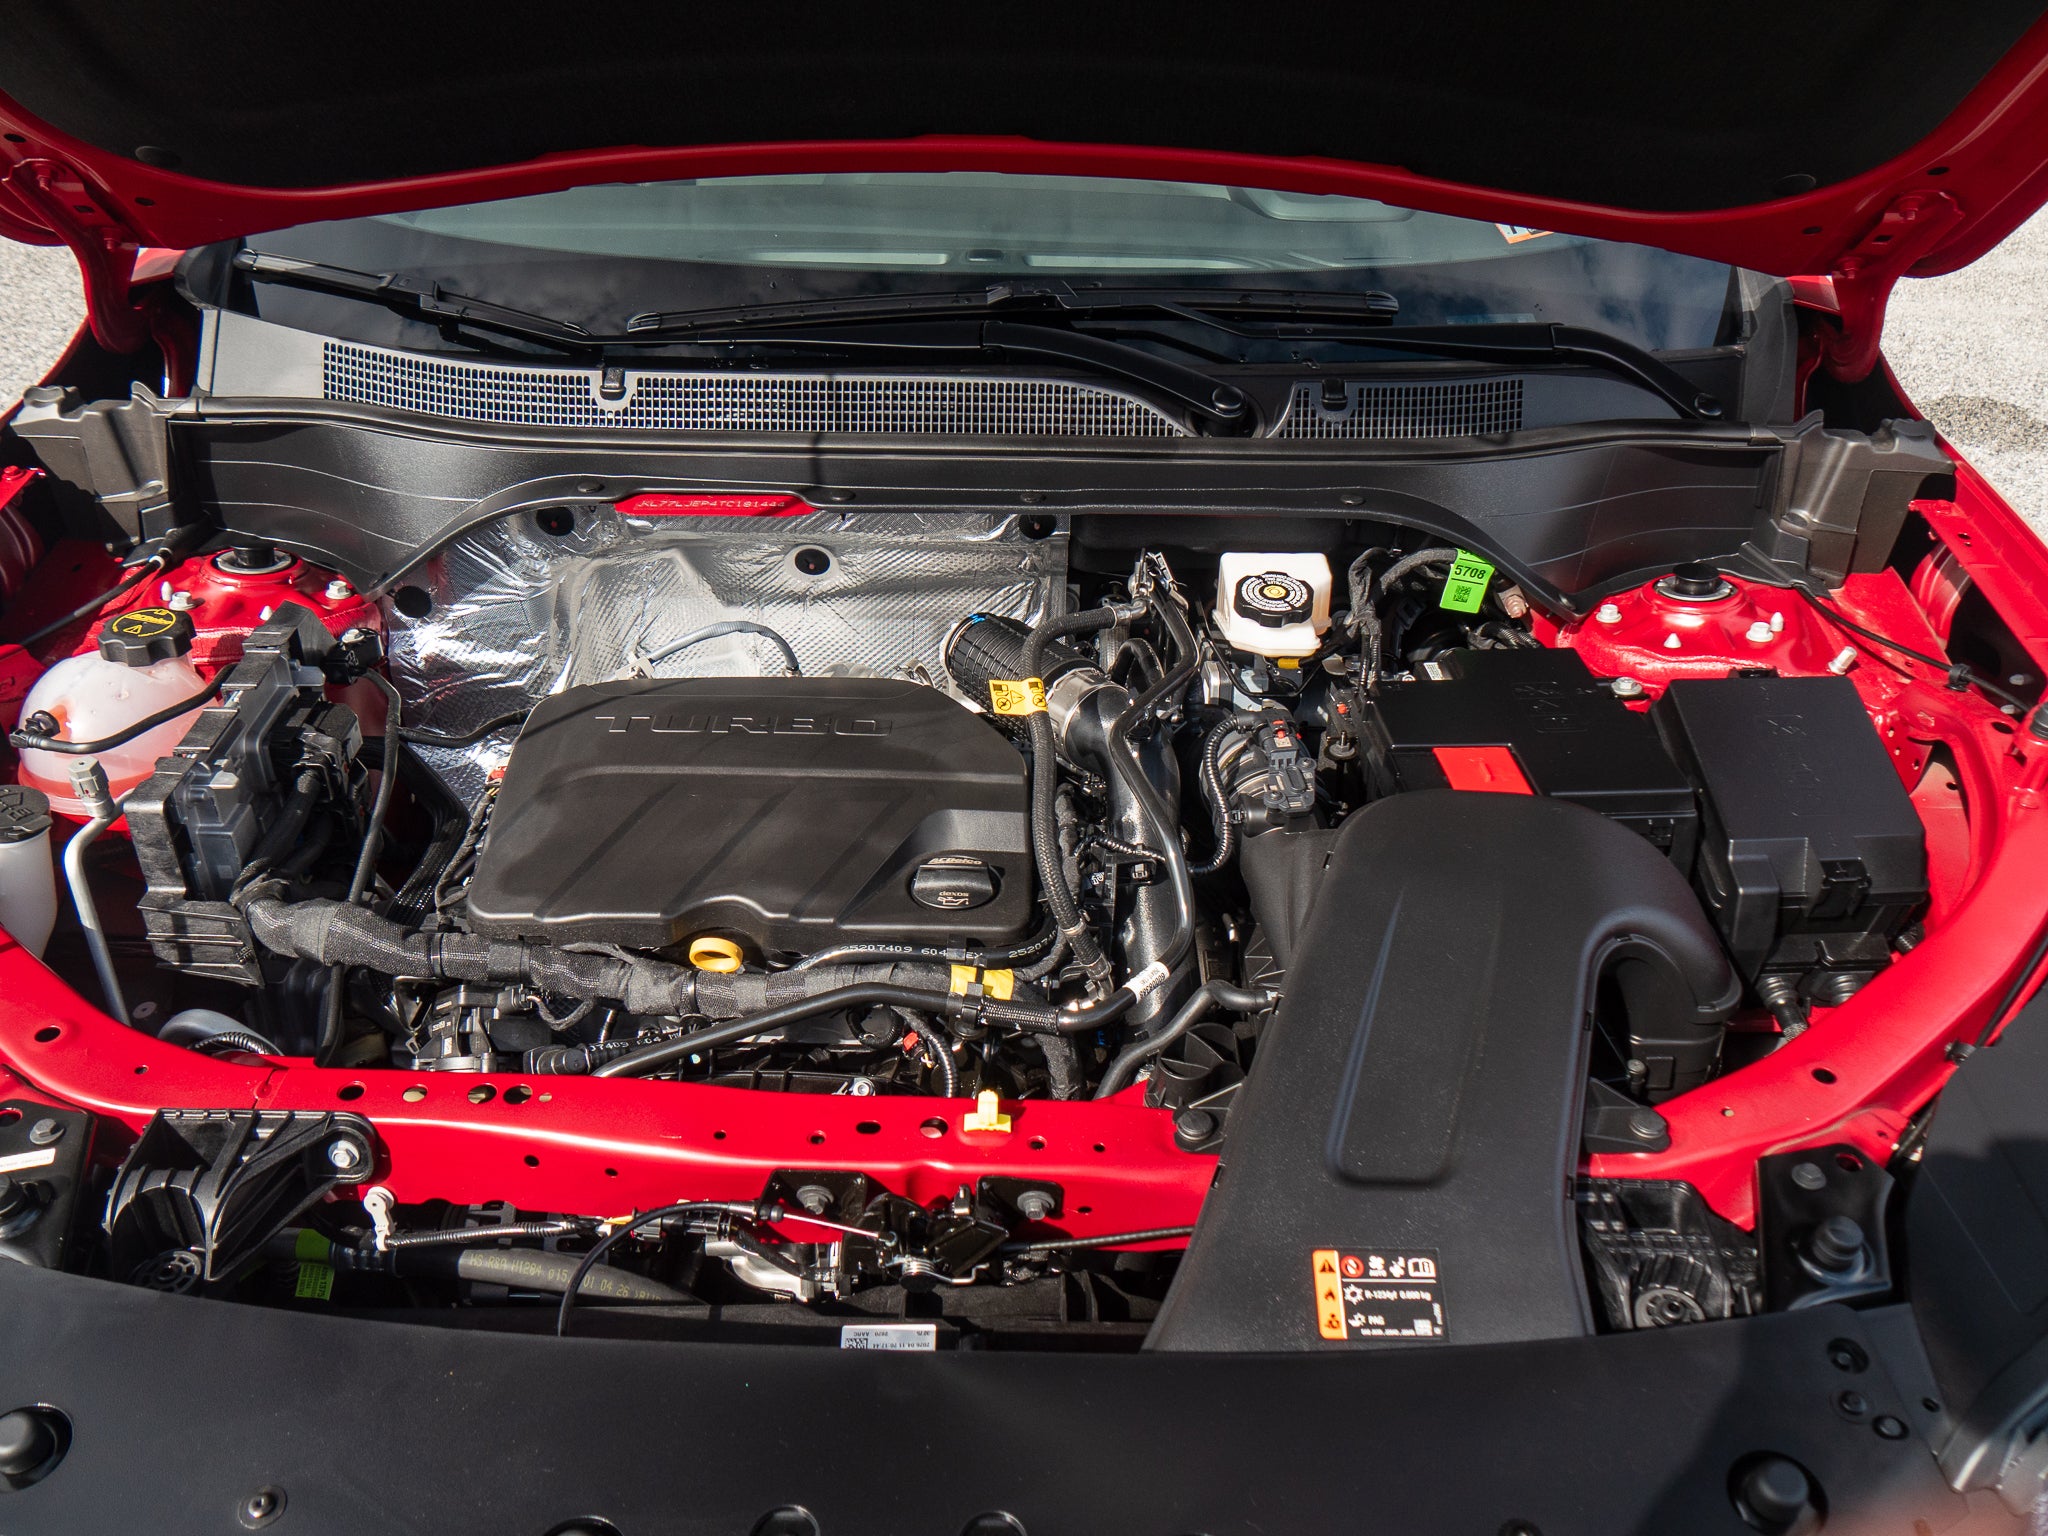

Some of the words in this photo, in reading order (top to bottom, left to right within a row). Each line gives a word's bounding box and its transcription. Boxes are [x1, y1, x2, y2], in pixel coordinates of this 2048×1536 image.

[1454, 564, 1486, 580] 5708
[595, 715, 893, 737] TURBO
[927, 857, 983, 865] ACDelco
[938, 890, 970, 898] dexos
[840, 944, 913, 953] 25207409
[616, 1283, 630, 1298] 26
